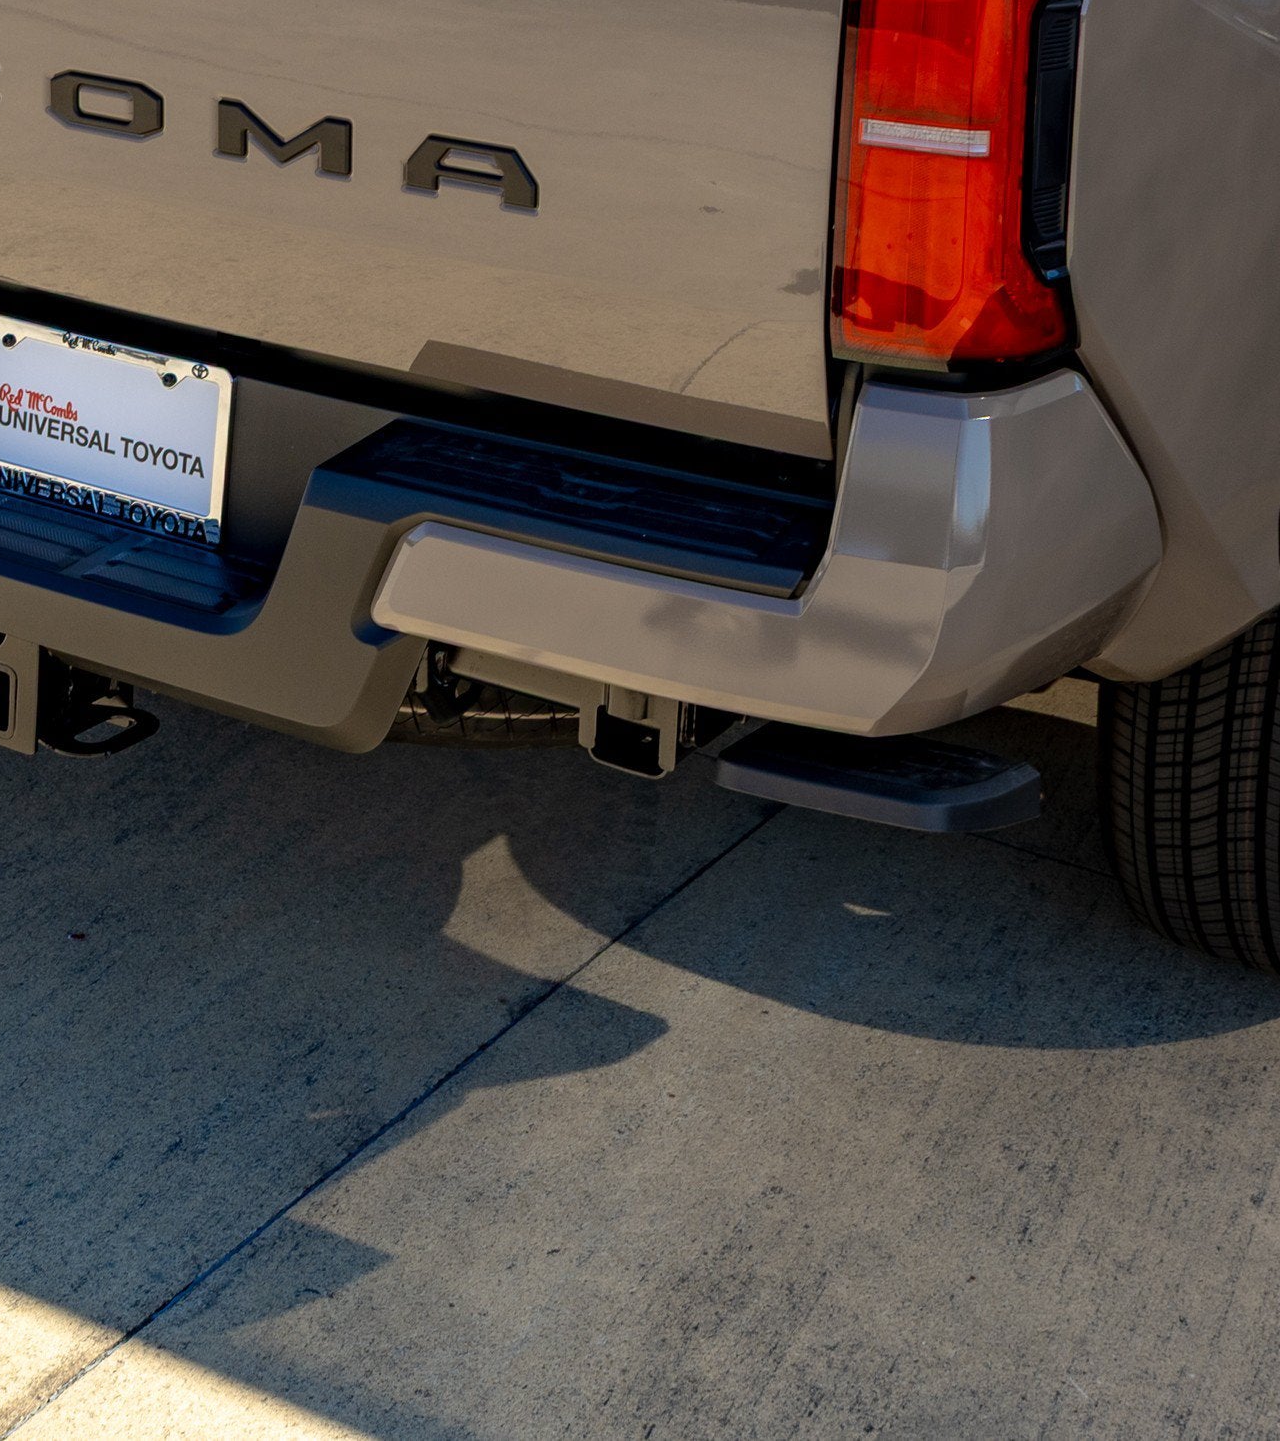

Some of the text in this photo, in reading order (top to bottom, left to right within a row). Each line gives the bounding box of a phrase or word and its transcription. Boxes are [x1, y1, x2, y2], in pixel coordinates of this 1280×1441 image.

[62, 331, 79, 349] Red
[0, 383, 78, 421] Red McCombs
[120, 436, 205, 478] TOYOTA
[116, 496, 208, 544] TOYOTA
